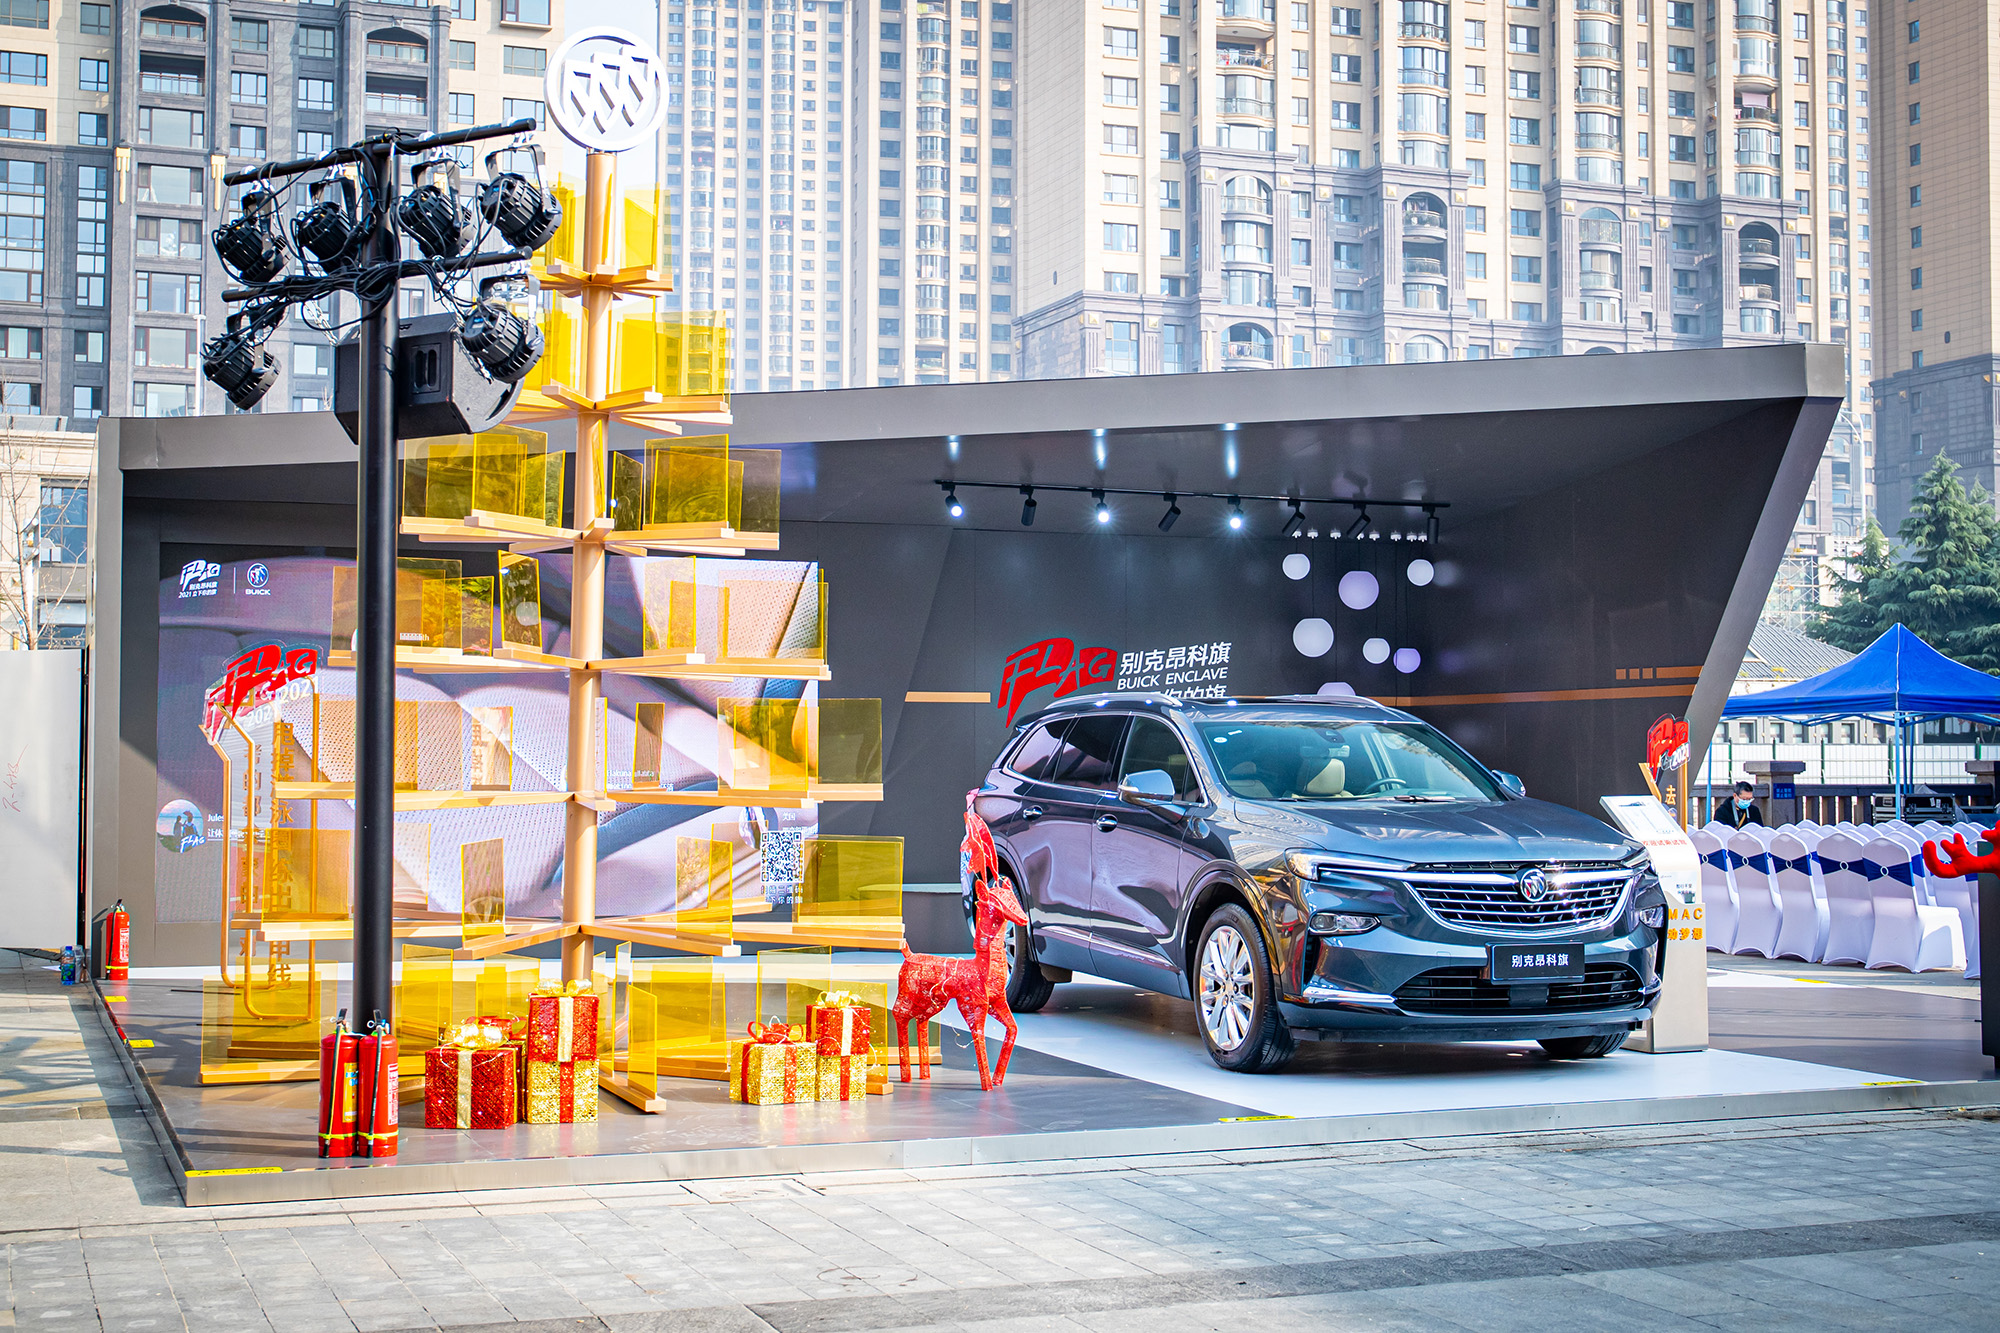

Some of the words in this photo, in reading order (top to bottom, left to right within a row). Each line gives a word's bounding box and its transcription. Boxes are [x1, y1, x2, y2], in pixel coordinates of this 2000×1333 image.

[180, 560, 221, 592] FLAG
[246, 588, 271, 596] BUICK
[1119, 641, 1232, 676] 别克昂科旗
[224, 645, 318, 720] FLAG
[997, 638, 1118, 728] FLAG
[1117, 674, 1160, 690] BUICK
[1165, 667, 1229, 685] ENCLAVE
[181, 835, 206, 853] FLAG
[1668, 907, 1703, 920] MAC
[1511, 953, 1569, 968] 别克昂科旗
